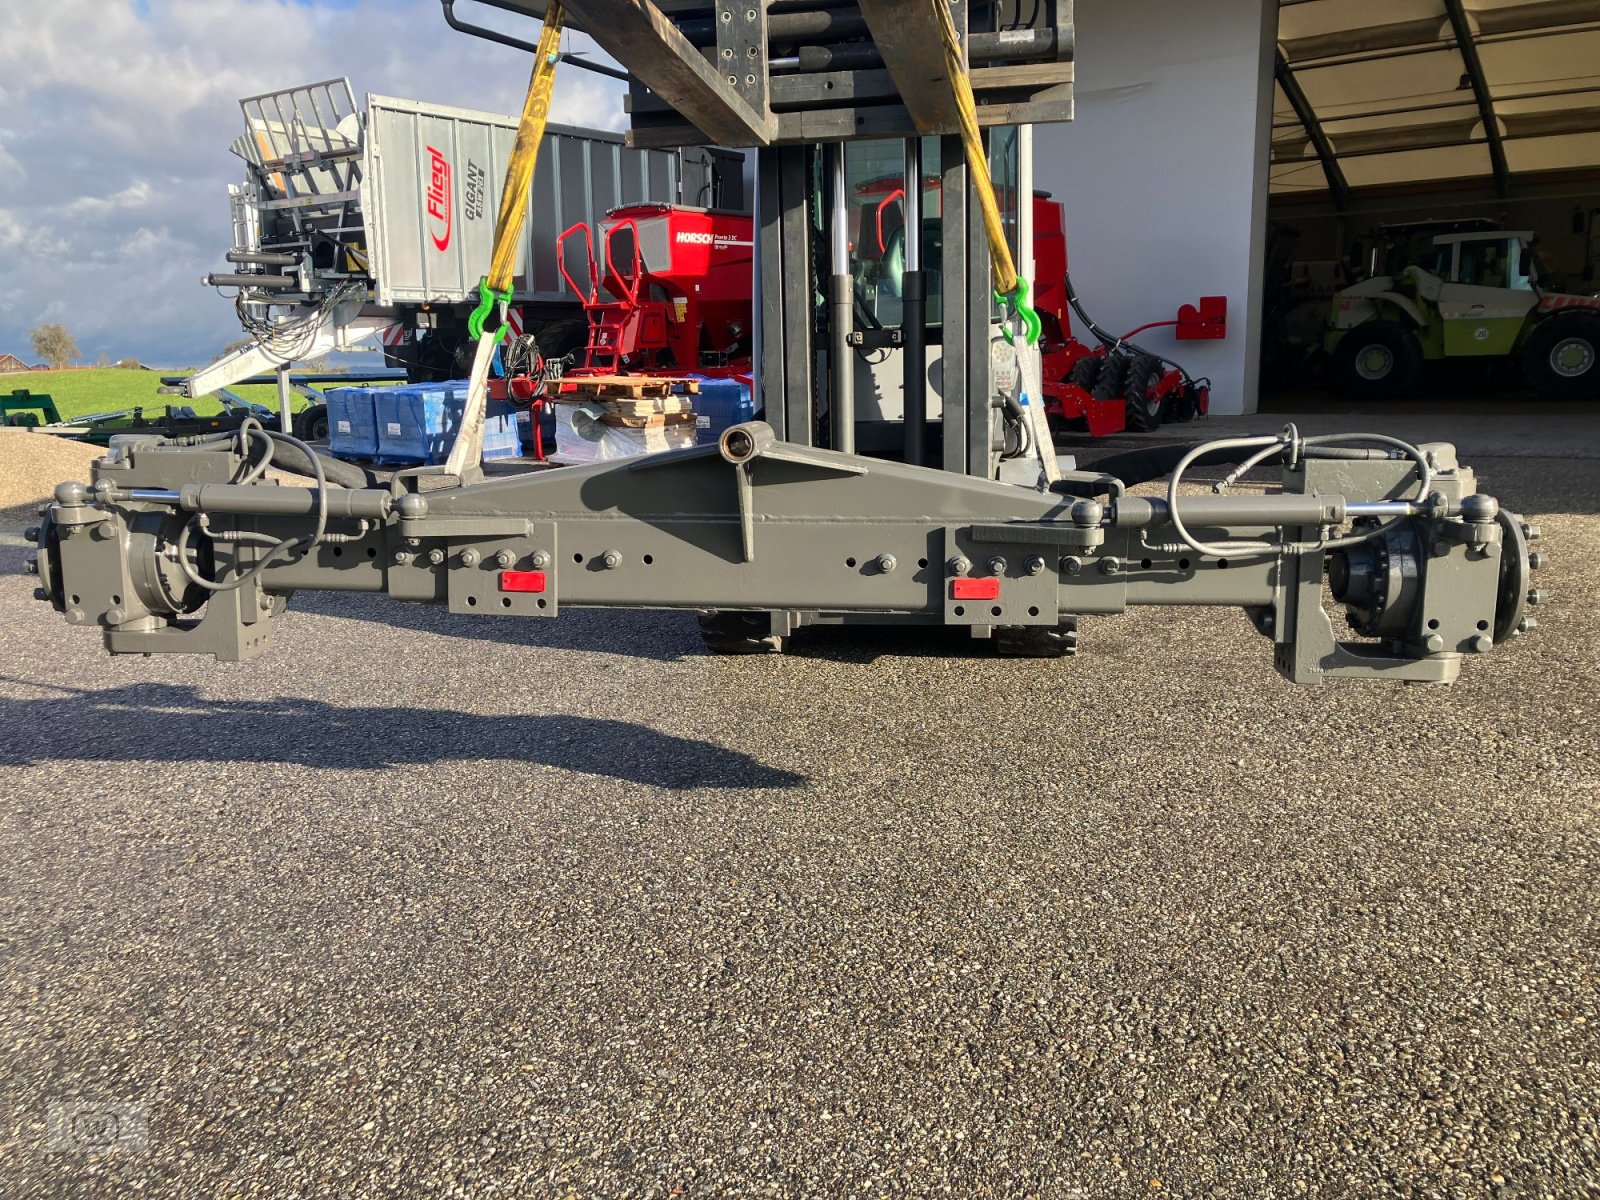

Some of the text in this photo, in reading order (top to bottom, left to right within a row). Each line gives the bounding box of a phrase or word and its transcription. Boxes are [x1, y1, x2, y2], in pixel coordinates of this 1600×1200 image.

[426, 145, 451, 221] Fliegl
[465, 158, 478, 221] GIGANT
[676, 231, 714, 244] HORSCH
